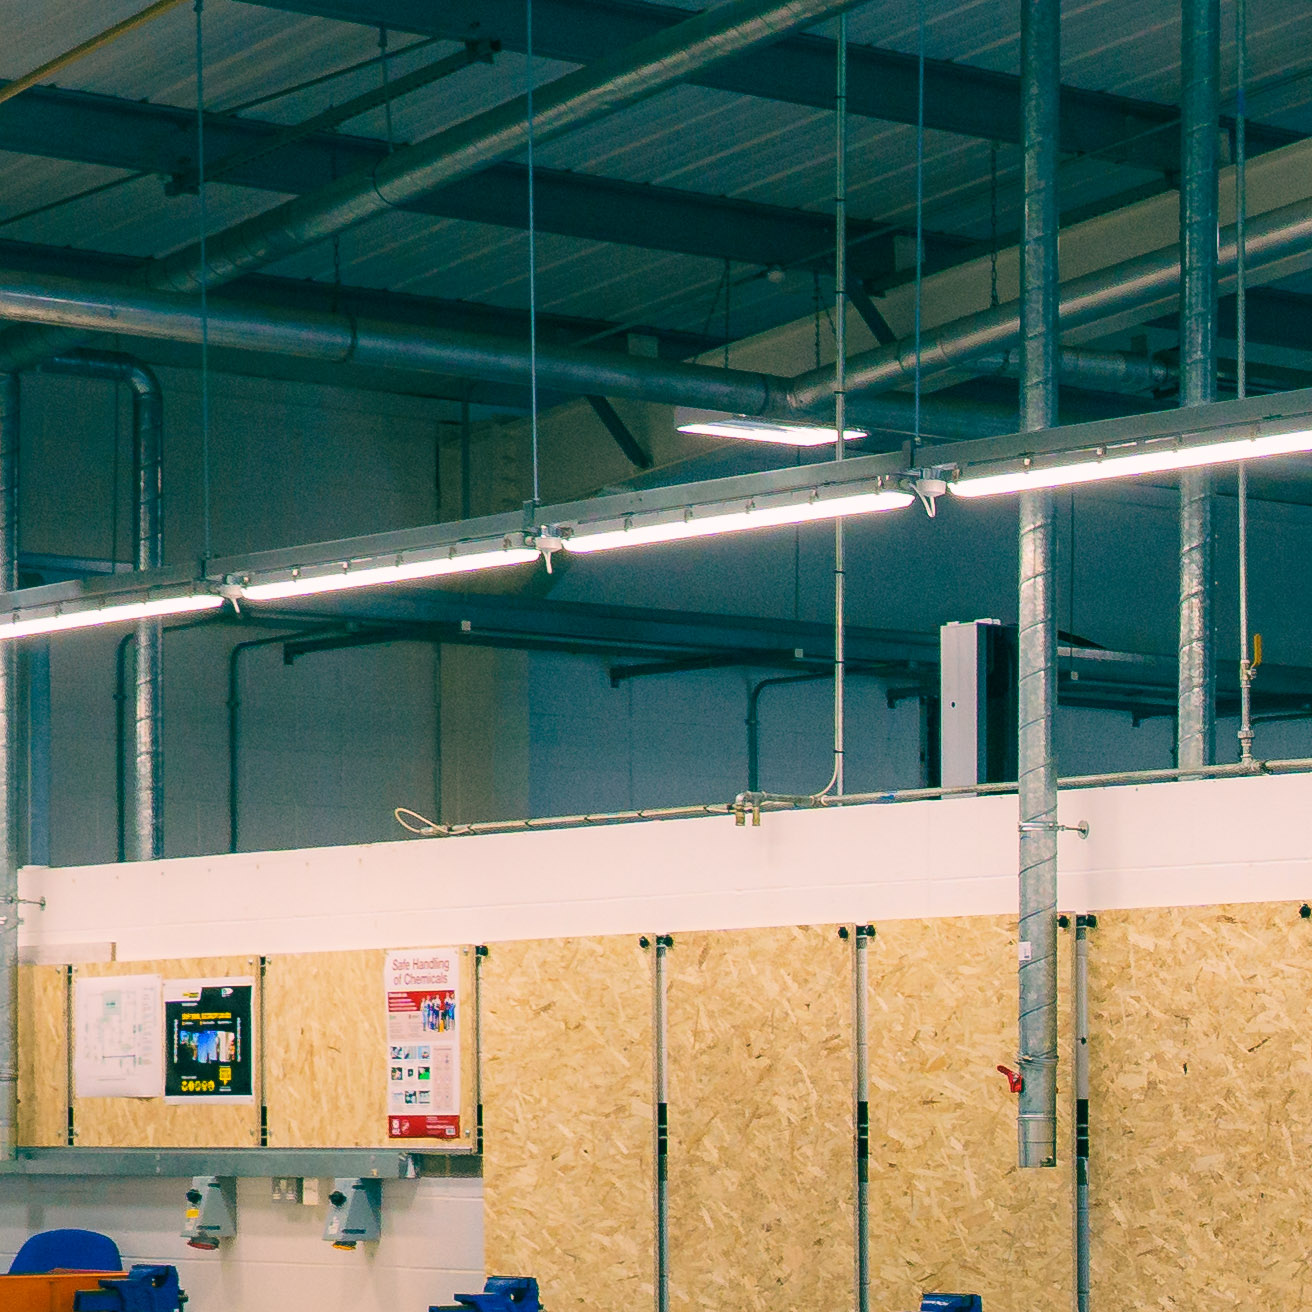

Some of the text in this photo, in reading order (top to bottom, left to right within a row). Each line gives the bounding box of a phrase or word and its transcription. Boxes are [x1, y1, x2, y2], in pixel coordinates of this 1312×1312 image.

[392, 957, 450, 972] Safe Handling
[393, 972, 448, 986] of Chemicals
